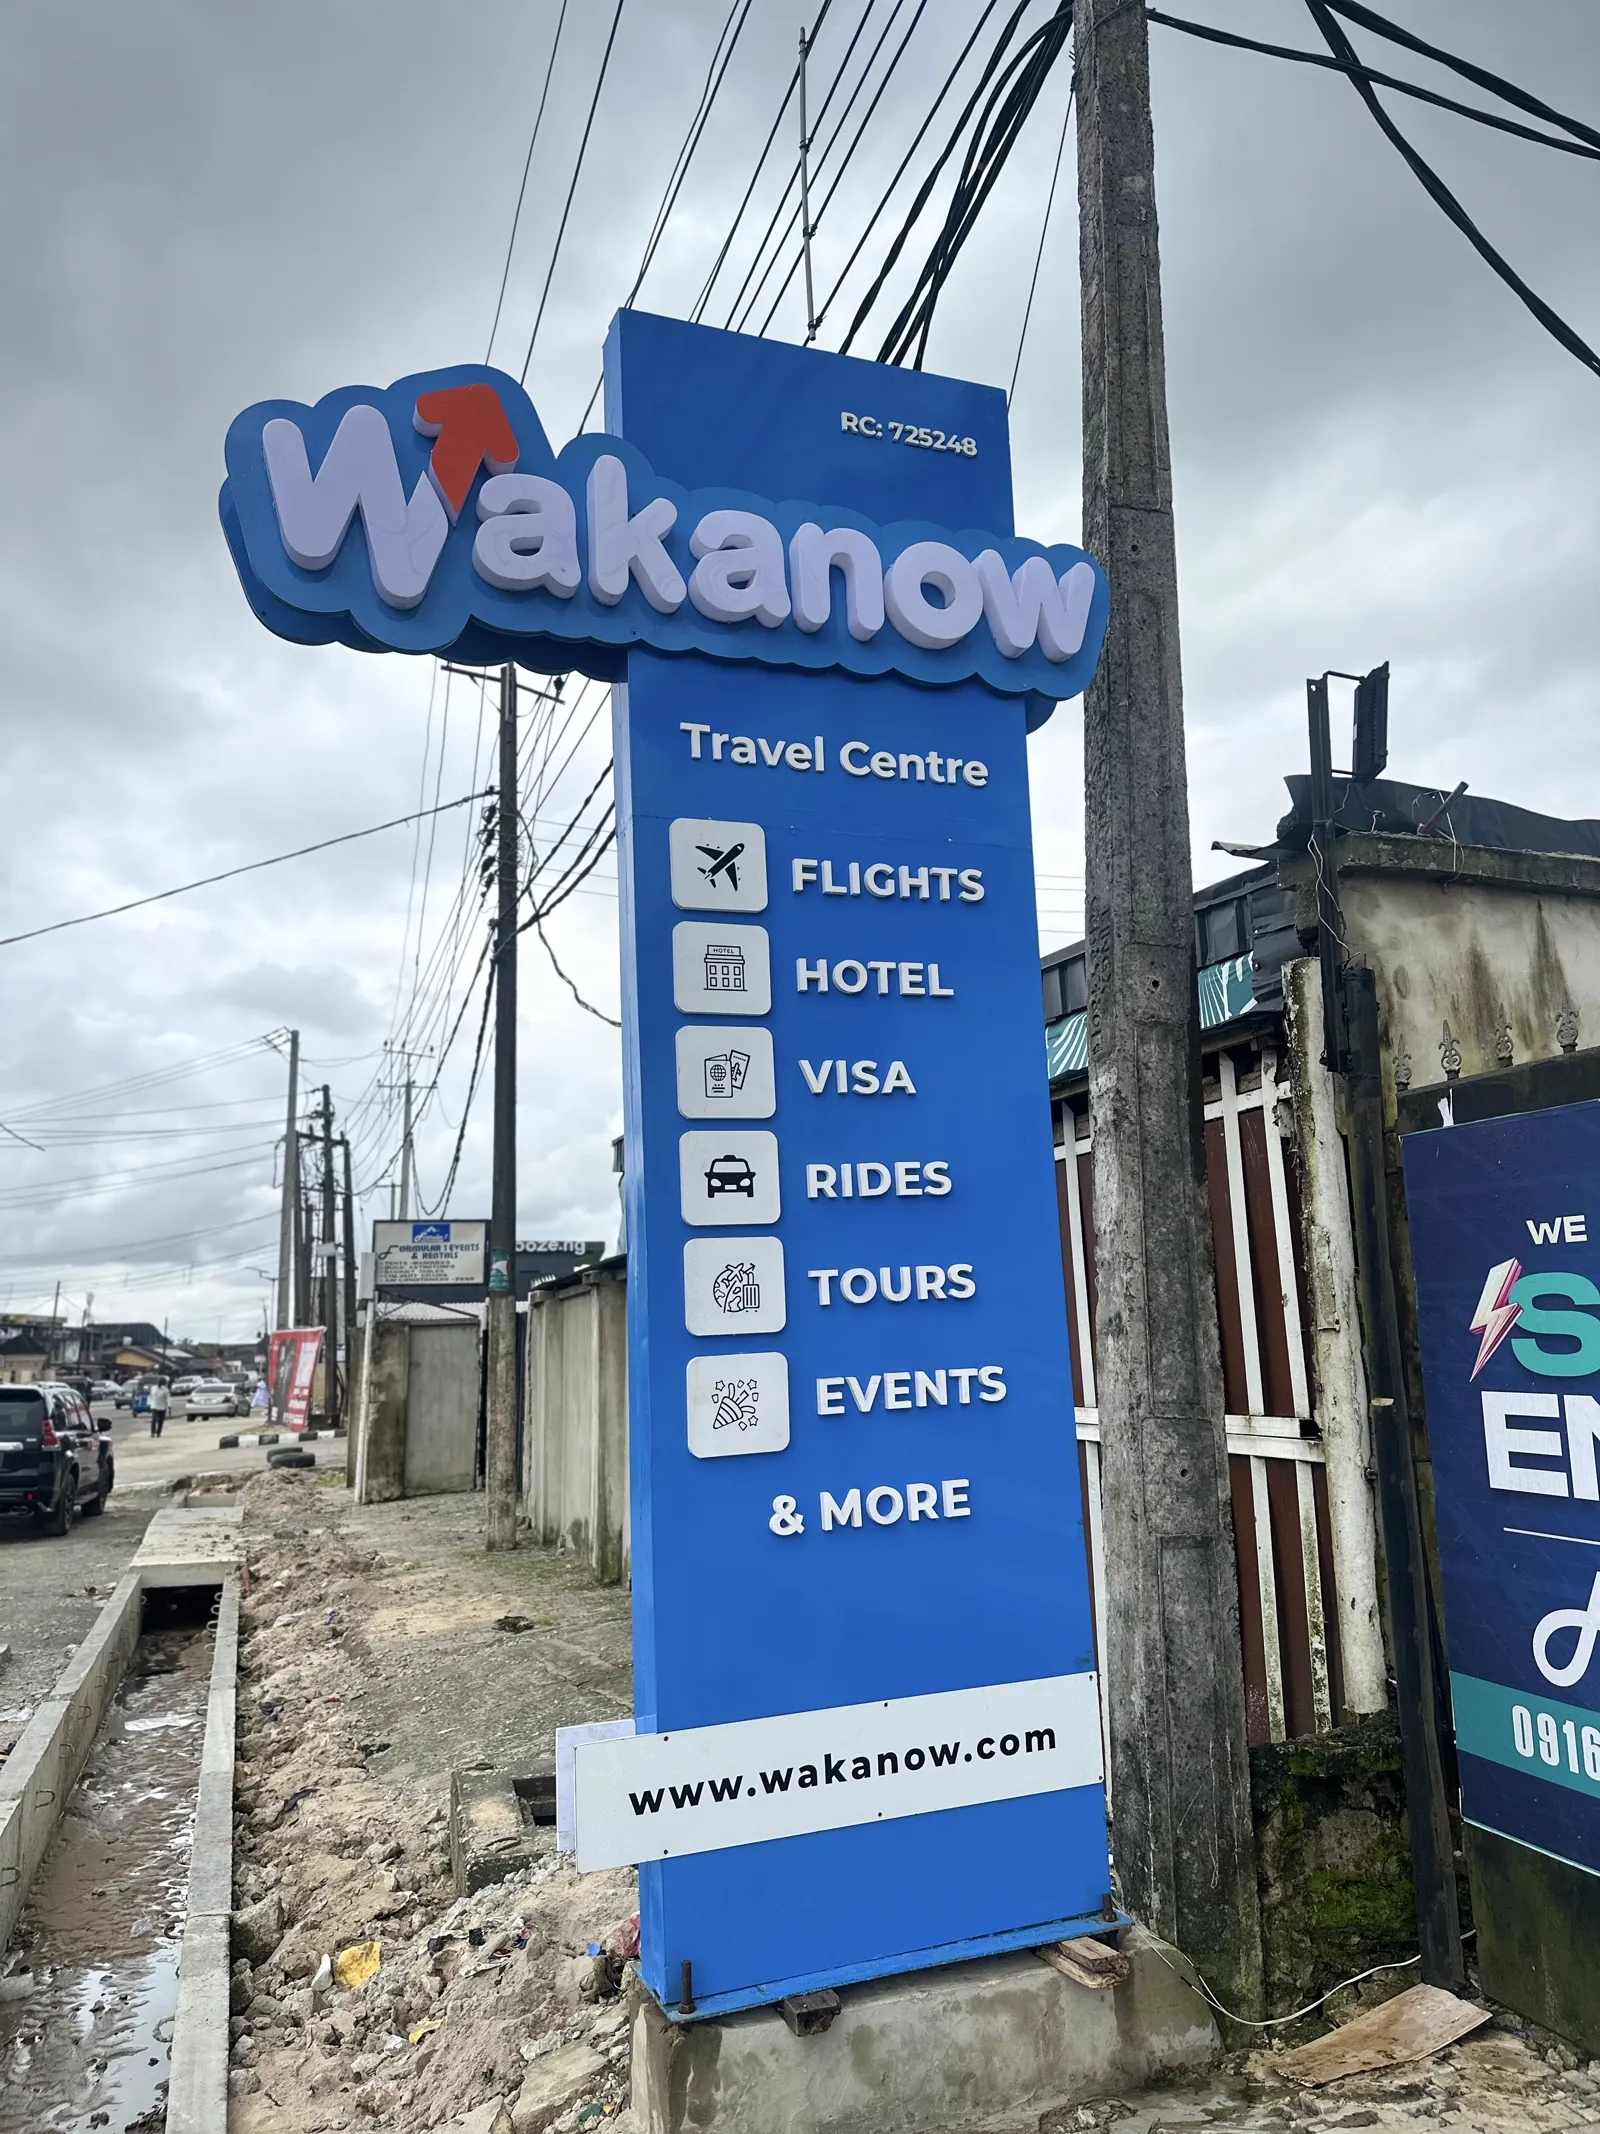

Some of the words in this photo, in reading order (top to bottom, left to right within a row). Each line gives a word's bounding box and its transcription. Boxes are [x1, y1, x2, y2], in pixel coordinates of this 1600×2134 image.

[840, 411, 883, 438] RC:
[888, 421, 978, 458] 725248
[262, 384, 1096, 663] Wakanow
[679, 721, 825, 773] Travel
[838, 740, 989, 788] Centre
[792, 858, 985, 902] FLIGHTS
[796, 957, 955, 997] HOTEL
[798, 1059, 917, 1095] VISA
[805, 1161, 953, 1198] RIDES
[449, 1243, 479, 1251] EVENTS
[1526, 1214, 1588, 1245] WE
[411, 1252, 418, 1260] &
[422, 1251, 459, 1259] RENTALS
[808, 1264, 976, 1306] TOURS
[816, 1366, 1008, 1415] EVENTS
[769, 1494, 805, 1536] &
[820, 1479, 971, 1531] MORE
[628, 1727, 1057, 1817] www.wakanow.com
